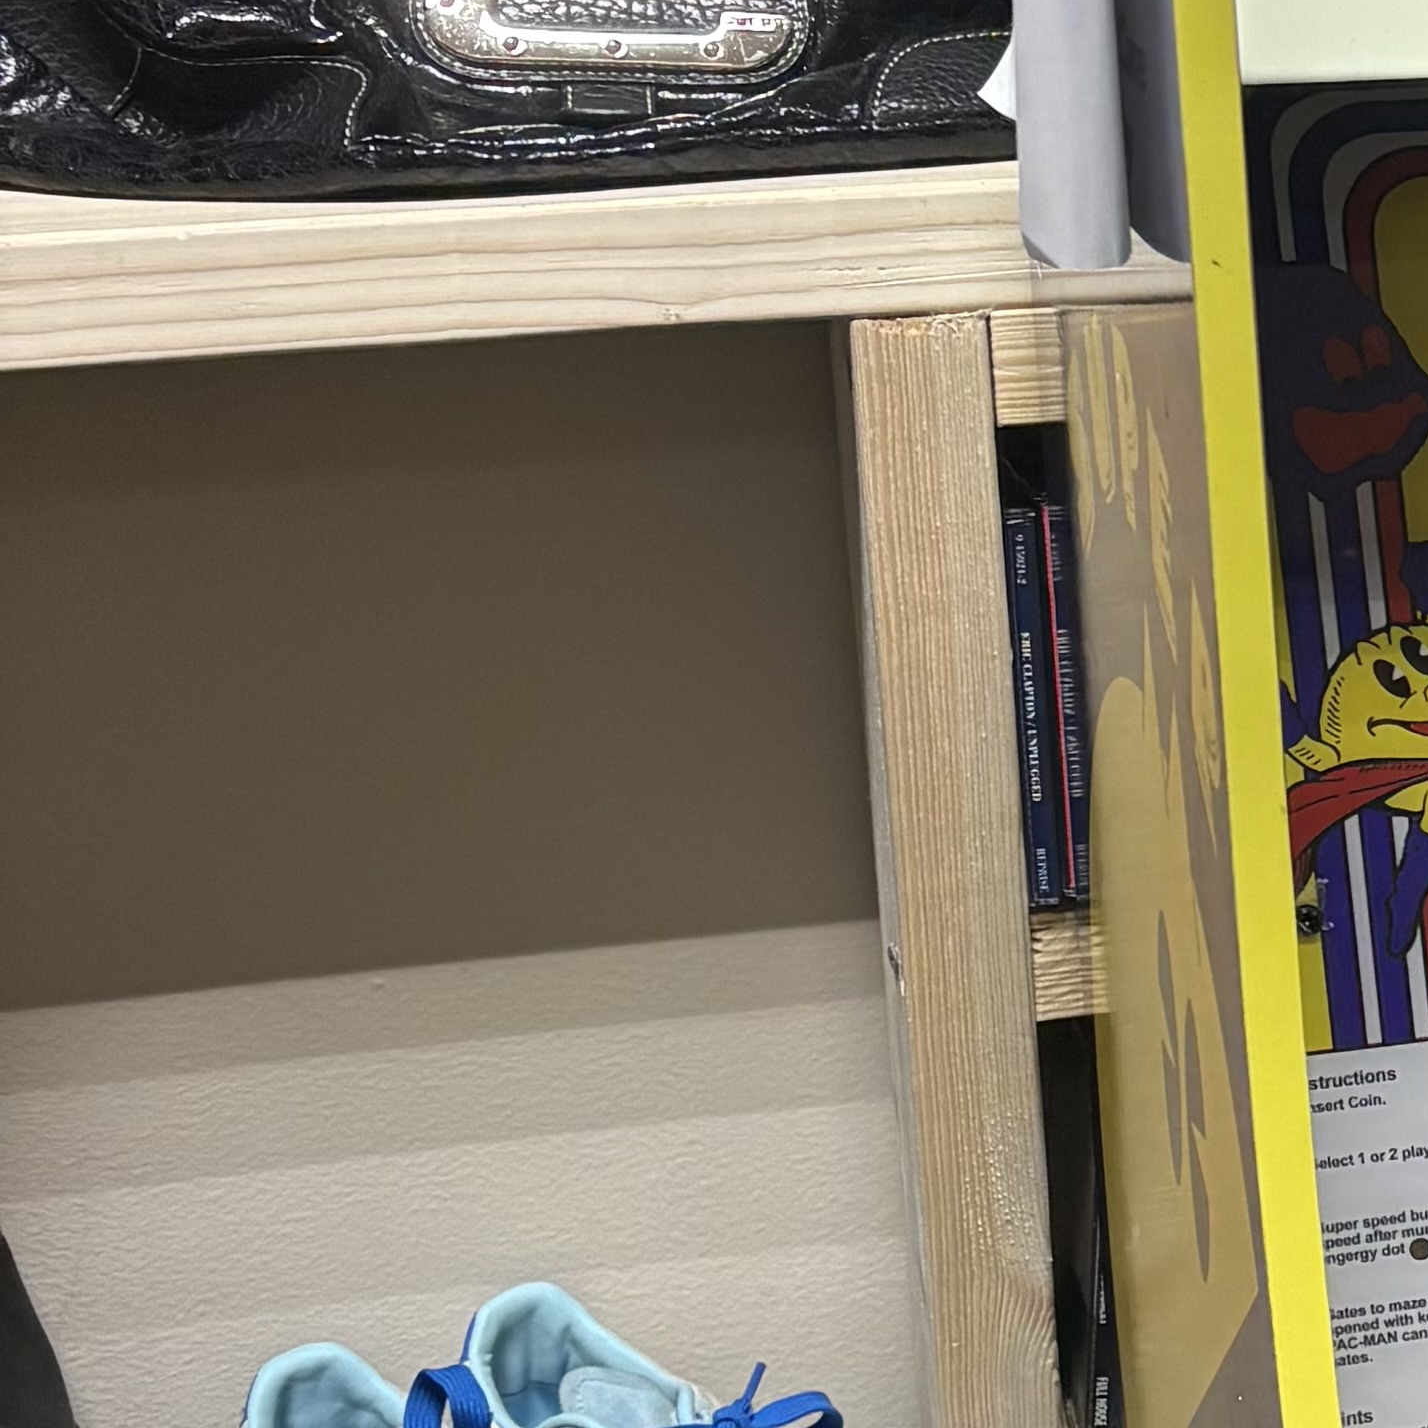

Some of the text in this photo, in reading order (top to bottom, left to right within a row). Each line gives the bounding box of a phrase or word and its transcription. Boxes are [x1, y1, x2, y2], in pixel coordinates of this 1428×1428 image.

[1347, 1092, 1388, 1110] Coin.
[1362, 1211, 1407, 1230] speed
[1364, 1228, 1399, 1245] after
[1381, 1242, 1406, 1258] dot
[1388, 1297, 1428, 1313] maze
[1383, 1313, 1415, 1330] with
